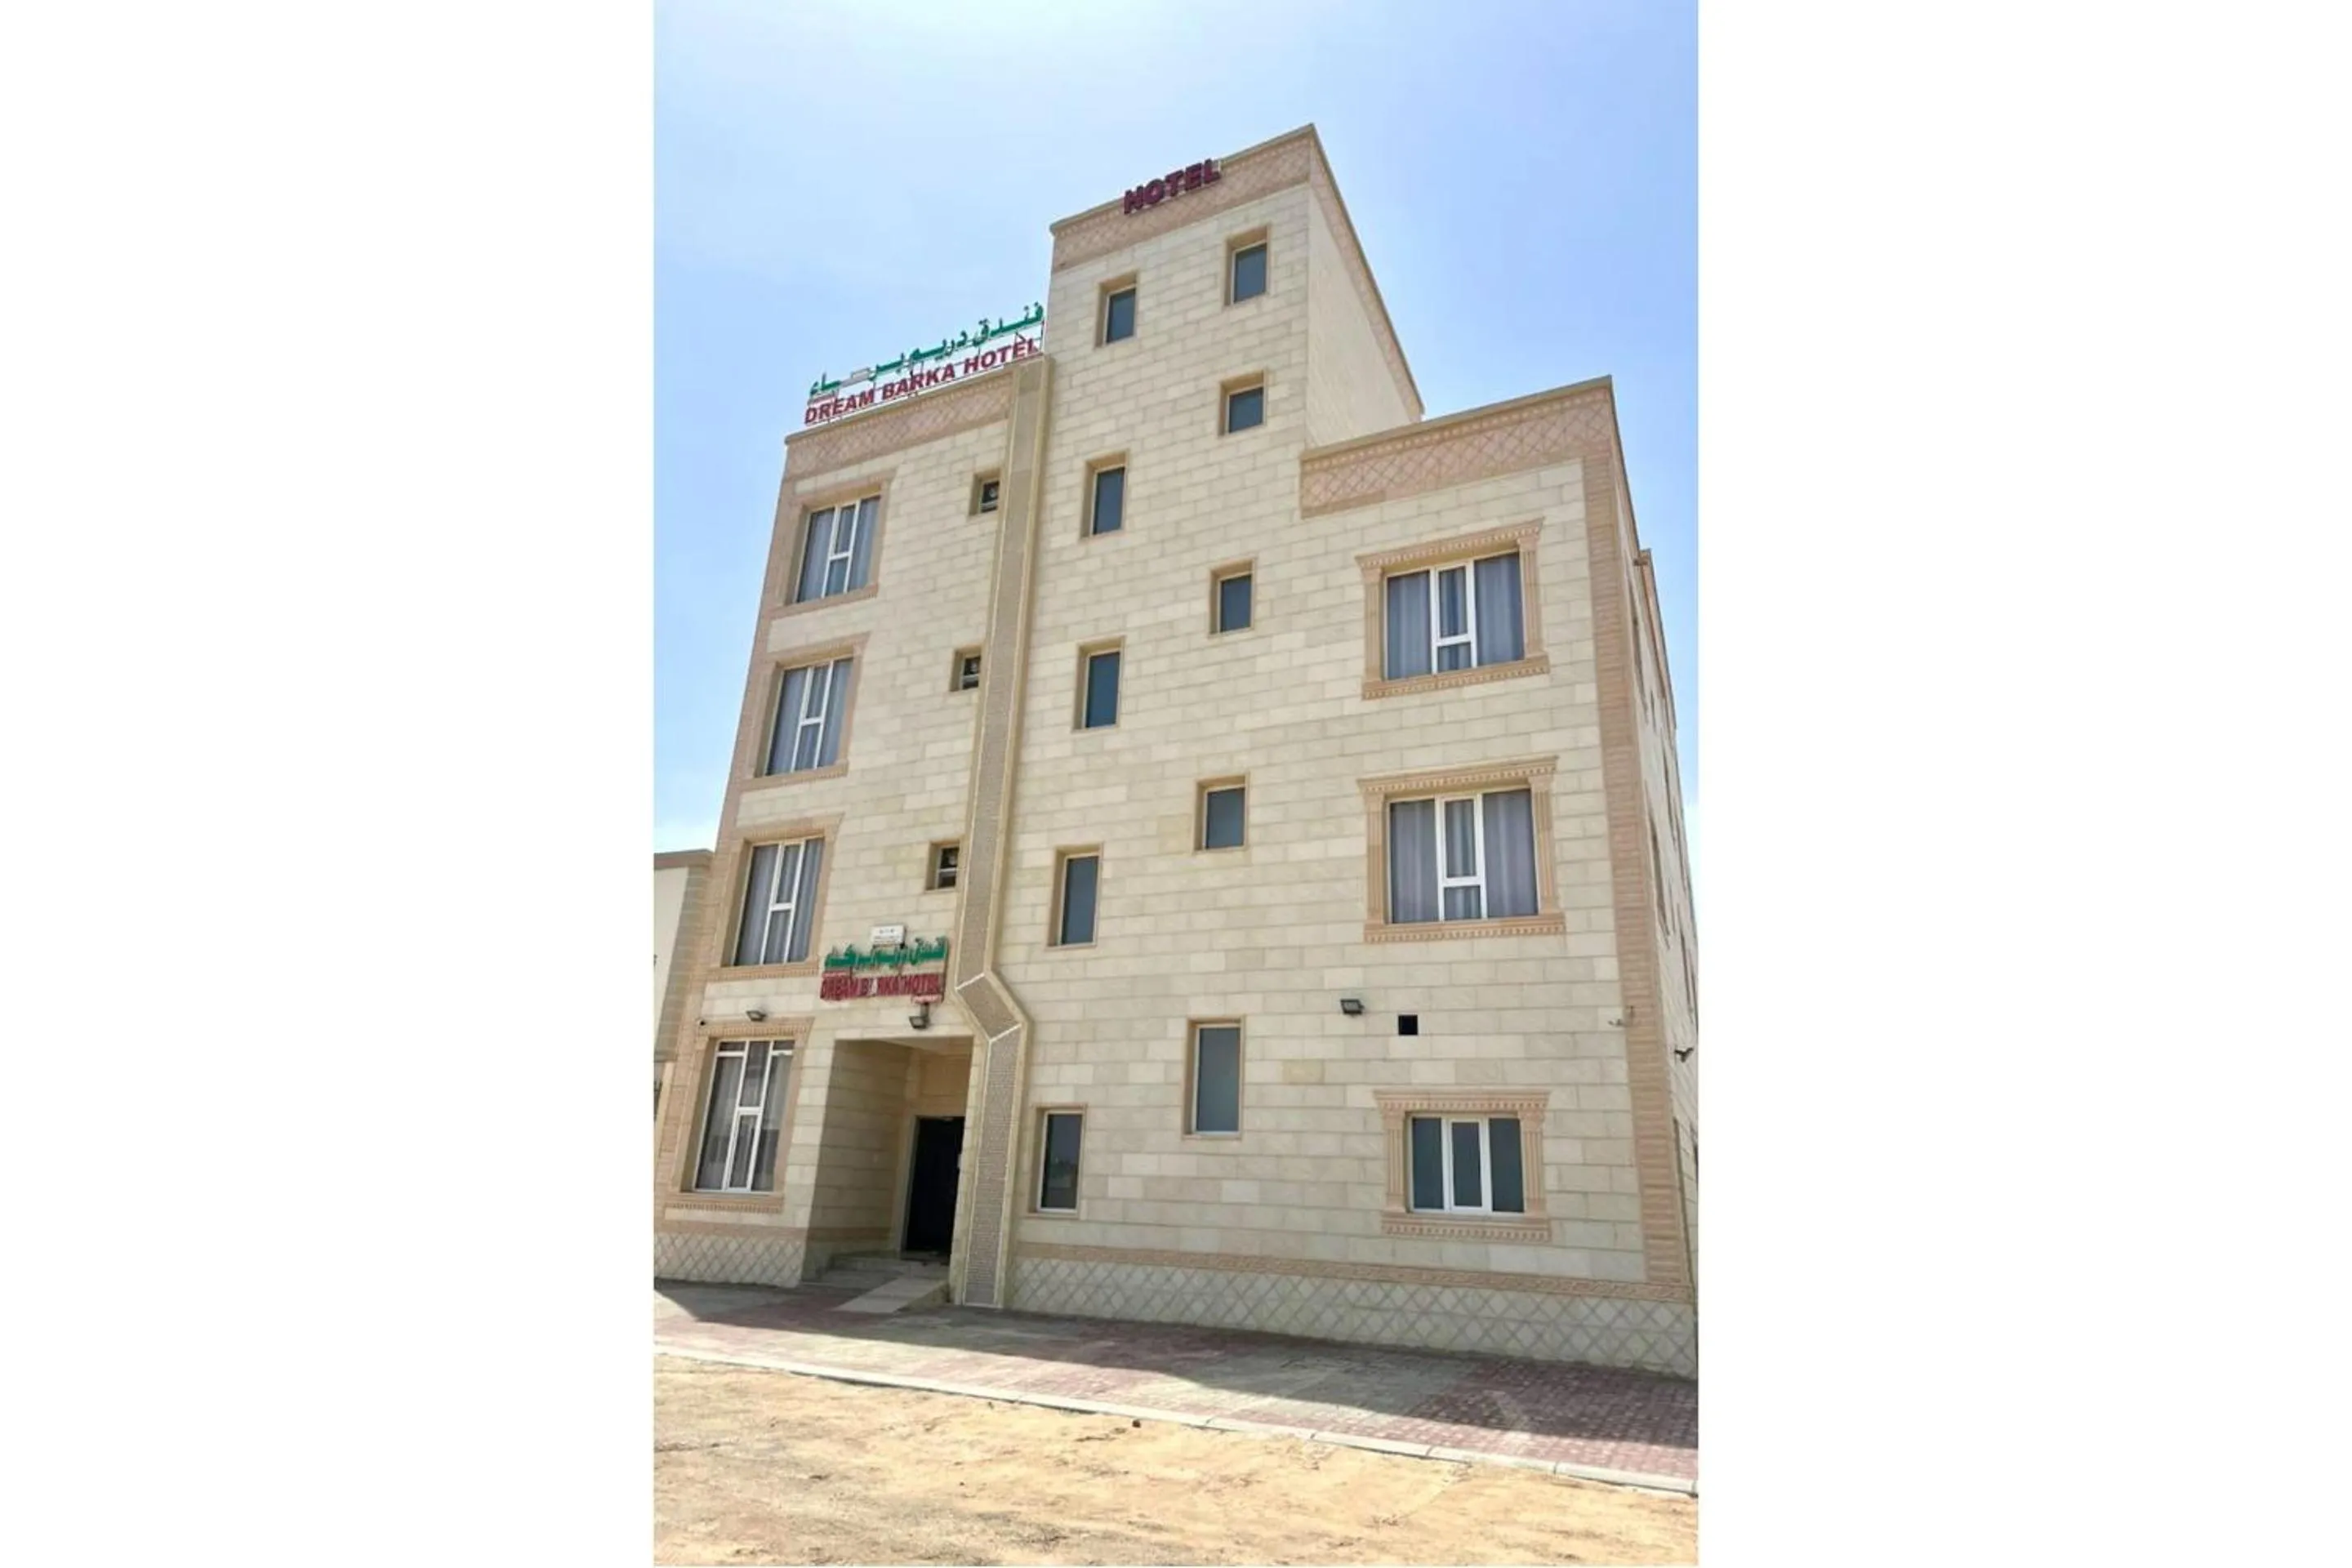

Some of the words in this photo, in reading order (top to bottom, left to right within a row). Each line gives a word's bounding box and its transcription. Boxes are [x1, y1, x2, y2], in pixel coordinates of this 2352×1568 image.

[1124, 158, 1221, 214] HOTEL
[973, 301, 1044, 347] فندق
[804, 388, 875, 425] DREAM
[882, 363, 956, 401] BARKA
[964, 337, 1039, 375] HOTEL
[809, 352, 906, 396] براء
[859, 975, 902, 998] BRKA
